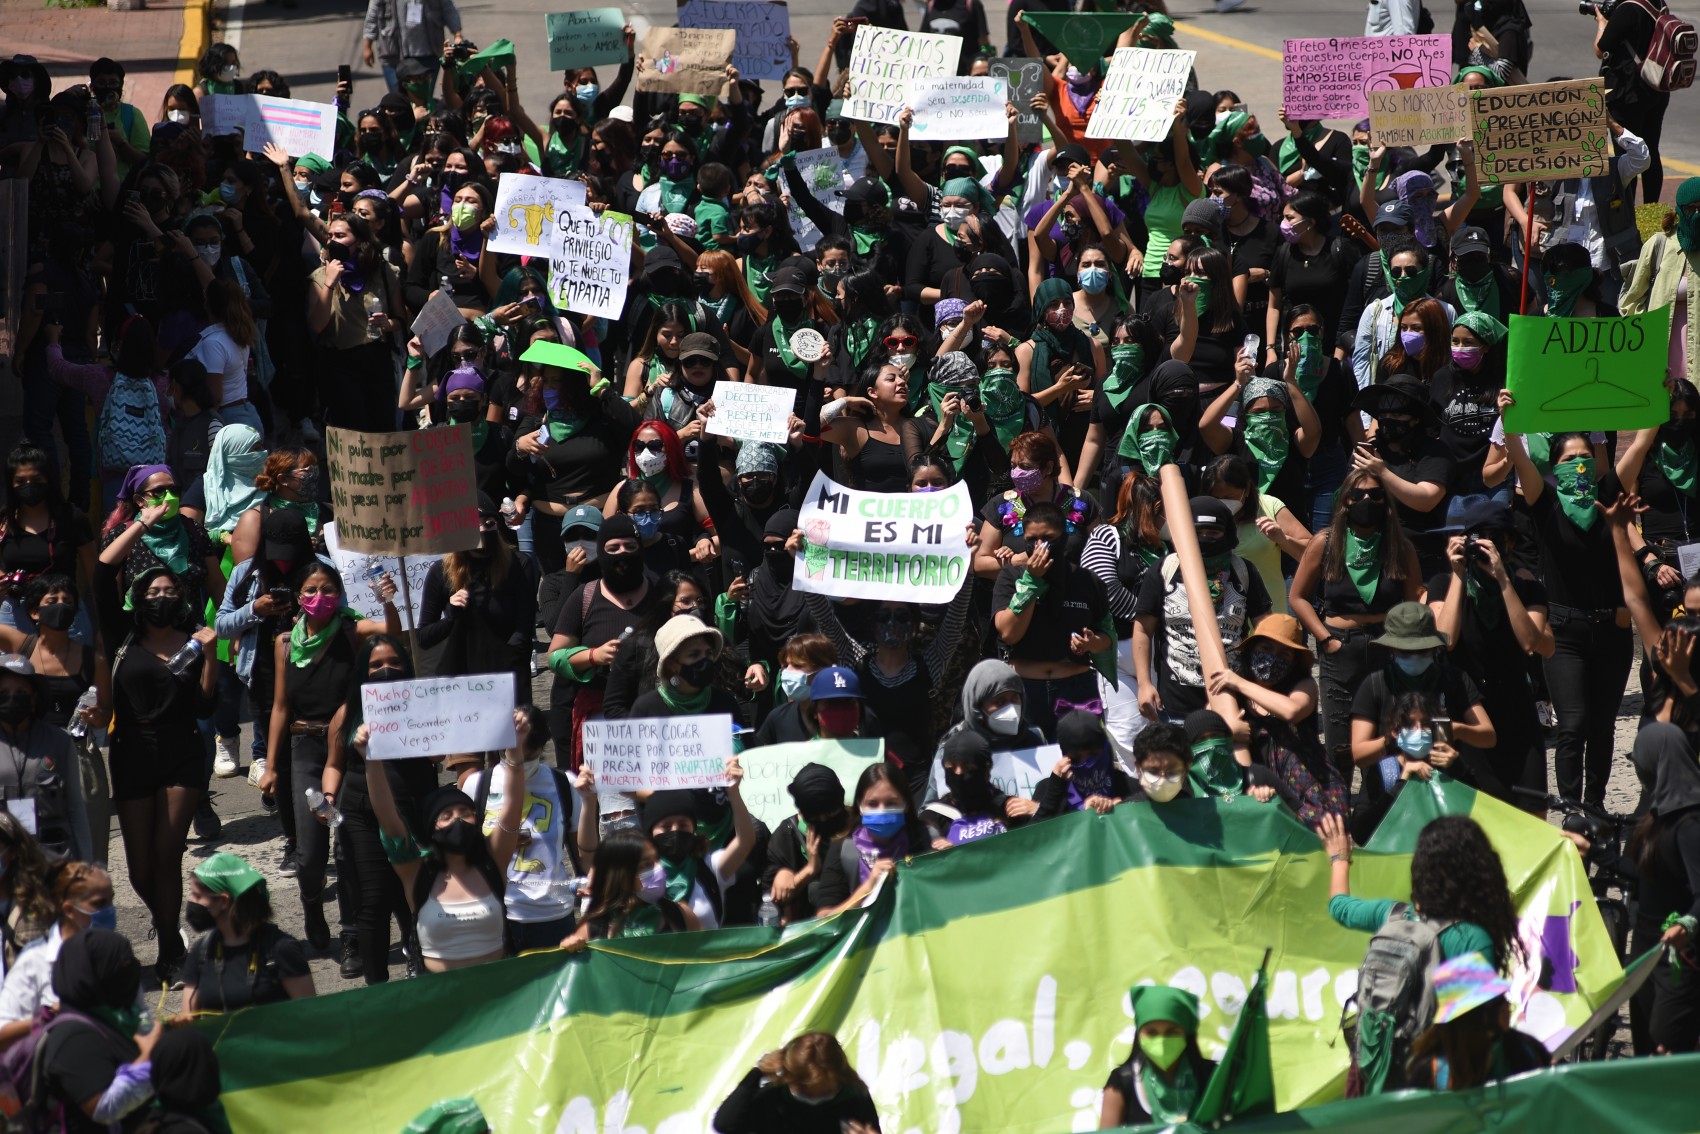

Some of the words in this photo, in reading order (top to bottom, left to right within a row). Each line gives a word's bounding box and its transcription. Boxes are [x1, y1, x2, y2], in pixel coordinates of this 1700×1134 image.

[889, 34, 944, 64] SOMOS
[1300, 41, 1326, 52] feto
[1330, 38, 1338, 52] 9
[1341, 38, 1383, 51] meses
[1389, 39, 1403, 48] es
[1284, 52, 1297, 63] de
[1300, 51, 1344, 63] nuestro
[1391, 48, 1413, 62] NO
[1433, 49, 1445, 59] es
[1287, 71, 1363, 84] IMPOSIBLE
[850, 77, 903, 103] SOMOS
[932, 80, 984, 91] maternidad
[1285, 83, 1299, 95] que
[1303, 84, 1316, 92] no
[1319, 81, 1362, 93] podamos
[1285, 93, 1319, 103] decidir
[1373, 94, 1397, 113] LXS
[1403, 92, 1456, 113] MORRXS
[1477, 86, 1585, 113] EDUCACIÓN,
[1120, 97, 1147, 116] TUS
[1285, 101, 1325, 112] nuestro
[950, 110, 963, 119] NO
[1419, 126, 1466, 141] ABORTAMOS
[1486, 127, 1582, 151] LIBERTAD
[1533, 147, 1555, 155] DE
[1494, 151, 1585, 173] DECISIÓN
[584, 220, 596, 238] TU
[563, 235, 612, 265] PRIVILEGIO
[553, 260, 566, 274] NO
[569, 260, 580, 278] TE
[582, 261, 608, 283] NUBLE
[610, 268, 622, 285] TU
[724, 390, 769, 403] DECIDE
[733, 402, 781, 413] SOCIEDAD
[725, 409, 772, 422] RESPETA
[729, 419, 773, 431] IGLESIA
[743, 430, 757, 438] SE
[327, 430, 343, 456] Ni
[348, 434, 373, 464] puta
[380, 444, 407, 466] por
[330, 460, 344, 482] Ni
[348, 462, 384, 487] madre
[390, 470, 415, 491] por
[334, 486, 347, 508] Ni
[384, 494, 406, 513] por
[816, 483, 850, 515] MI
[858, 493, 960, 520] CUERPO
[336, 516, 349, 540] Ni
[350, 518, 397, 541] muerta
[400, 526, 423, 548] por
[864, 521, 898, 544] ES
[911, 522, 943, 545] MI
[829, 549, 965, 588] TERRITORIO
[343, 573, 356, 586] El
[365, 689, 410, 702] Mucho
[365, 701, 408, 716] Piernas
[370, 721, 399, 735] Poco
[586, 725, 599, 738] NI
[607, 724, 632, 740] PUTA
[639, 724, 659, 740] POR
[666, 724, 699, 741] COGER
[586, 743, 597, 756] NI
[604, 744, 641, 758] MADRE
[646, 744, 665, 757] POR
[670, 744, 704, 758] DEBER
[603, 761, 641, 773] PRESA
[651, 762, 670, 775] POR
[675, 758, 724, 775] ABORTAR
[601, 775, 643, 787] MUERTA
[650, 776, 670, 787] POR
